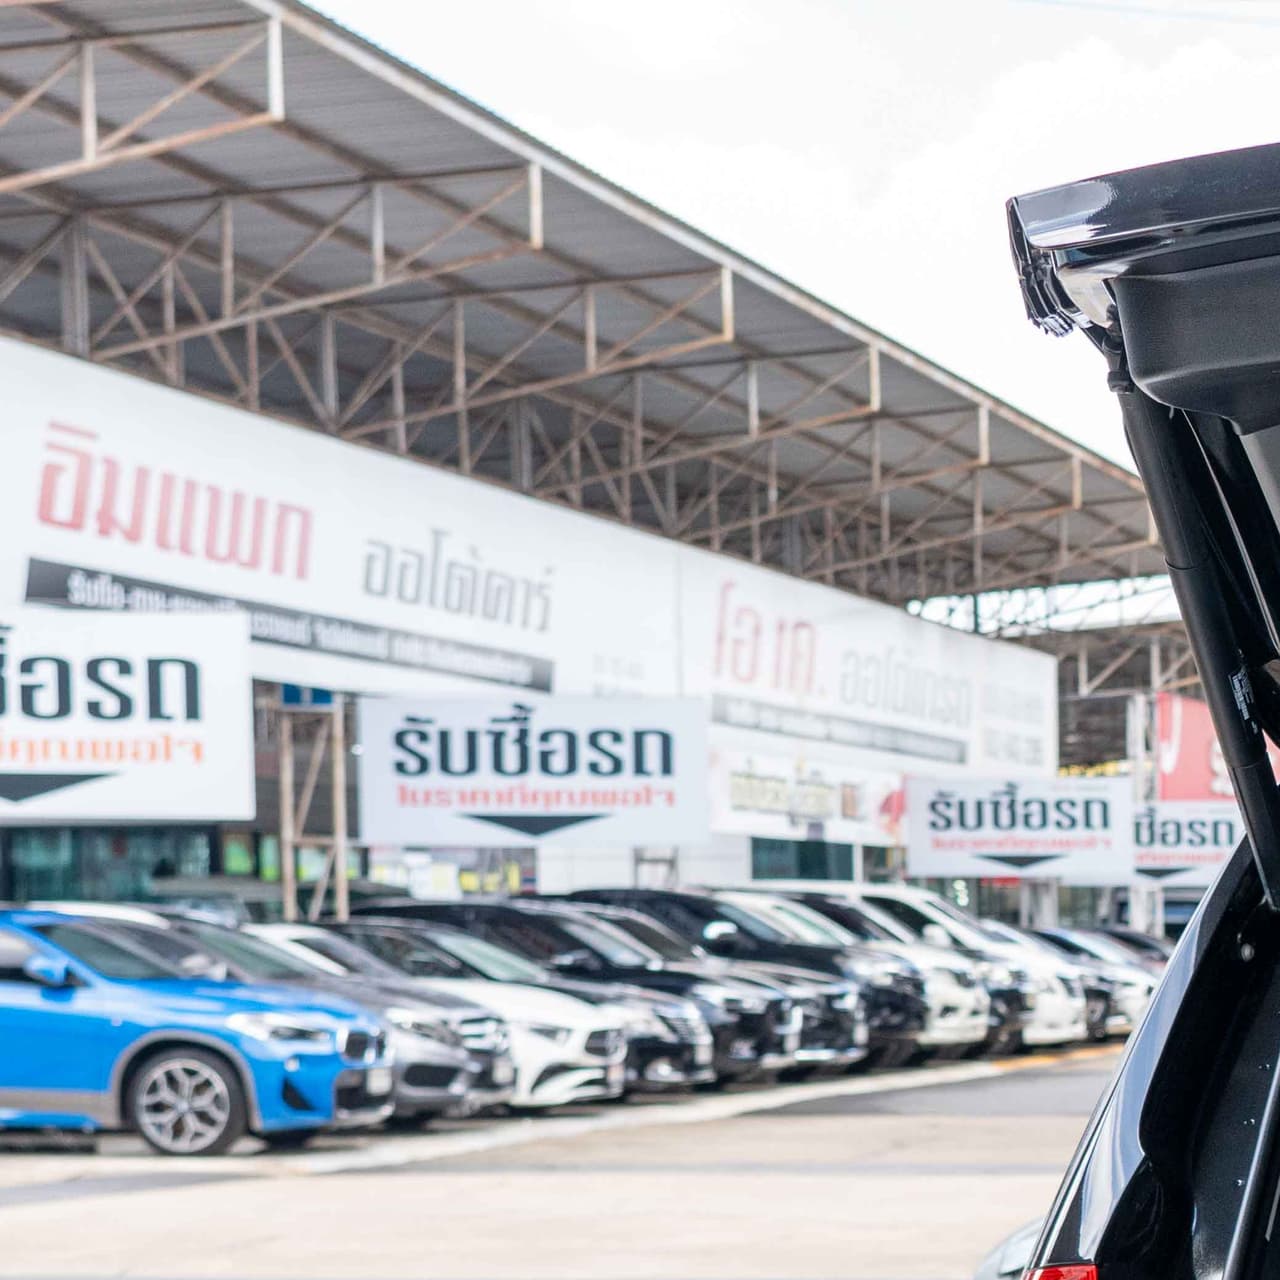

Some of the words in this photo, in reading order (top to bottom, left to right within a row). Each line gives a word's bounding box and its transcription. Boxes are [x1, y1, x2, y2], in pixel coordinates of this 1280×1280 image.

[394, 703, 673, 777] รับซื้อรถ
[929, 782, 1110, 832] รับซื้อรถ
